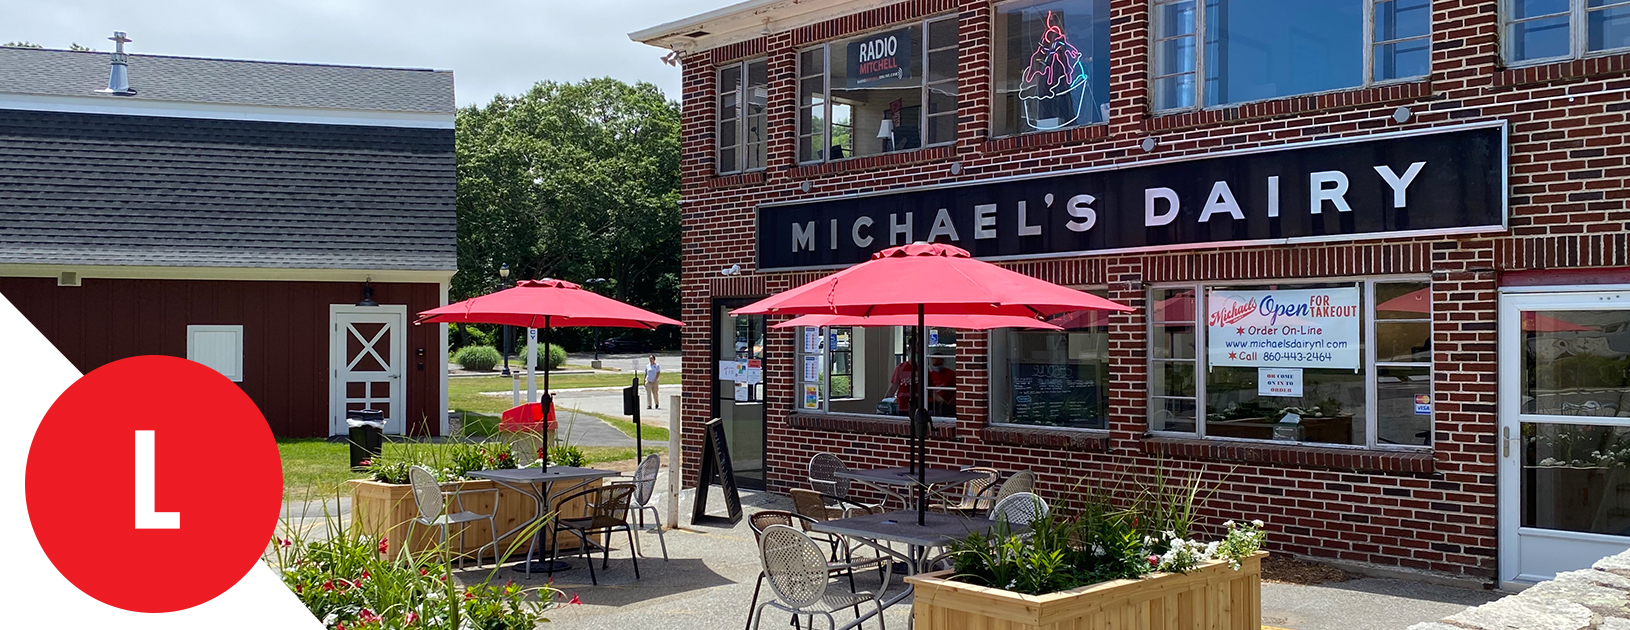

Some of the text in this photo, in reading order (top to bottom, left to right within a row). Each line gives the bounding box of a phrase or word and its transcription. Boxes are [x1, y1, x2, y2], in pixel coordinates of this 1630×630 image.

[859, 35, 898, 63] RADIO
[859, 56, 898, 75] MITCHELL
[791, 161, 1427, 253] MICHAEL'S DAIRY
[1259, 294, 1310, 326] Open
[1310, 295, 1330, 306] FOR
[1310, 305, 1357, 318] TAKEOUT
[1248, 326, 1323, 335] Order On-Line
[1225, 339, 1348, 351] www.michaelsdairynl.com
[1238, 351, 1332, 362] Call 860-443-2464
